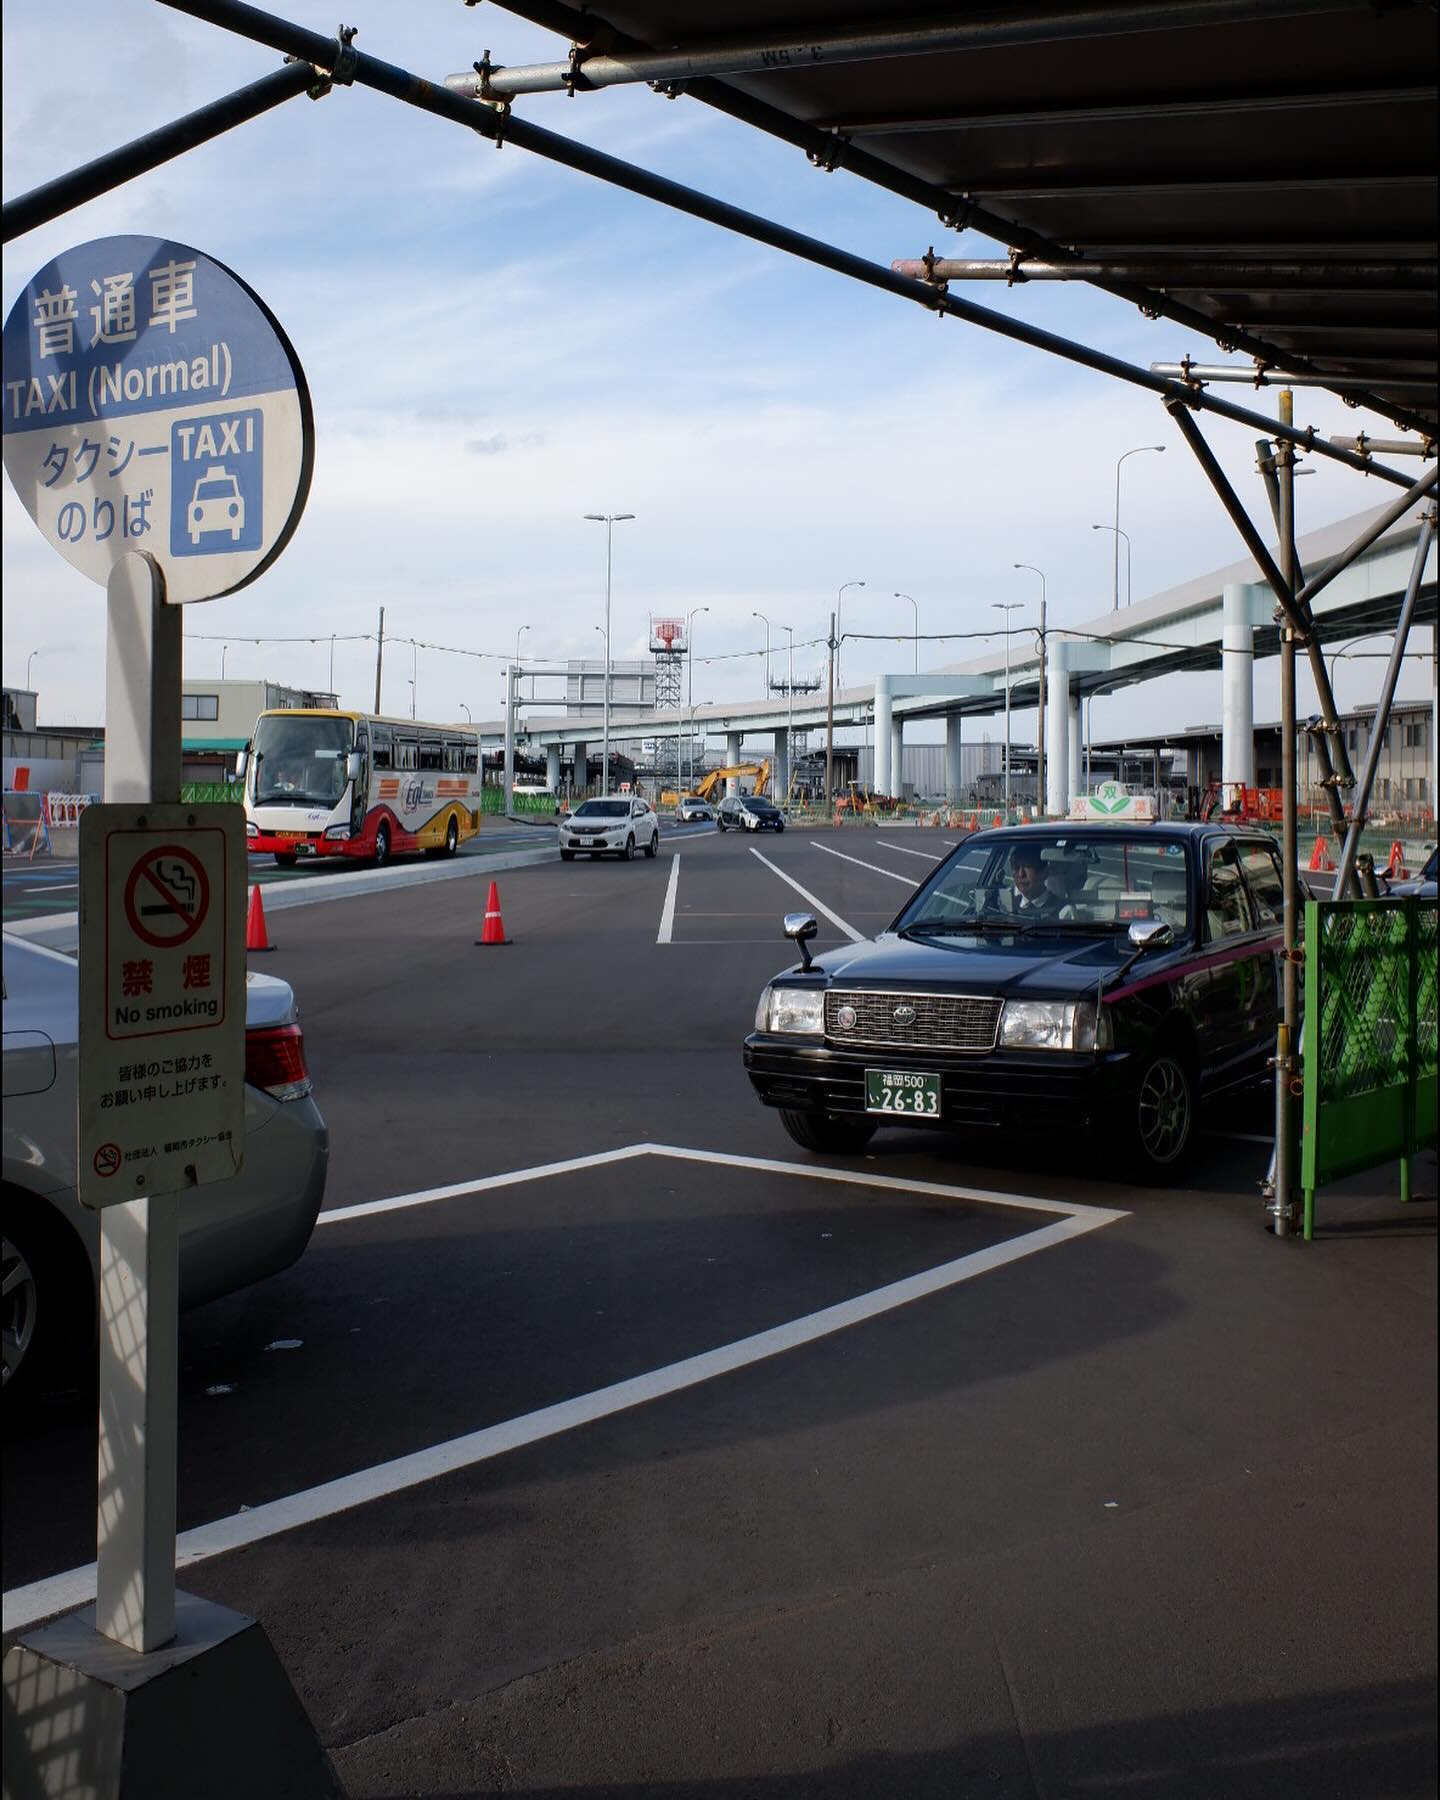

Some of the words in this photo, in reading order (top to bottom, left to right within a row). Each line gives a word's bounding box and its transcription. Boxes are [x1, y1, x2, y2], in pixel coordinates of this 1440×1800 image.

[33, 259, 199, 360] 普通車
[7, 370, 77, 419] TAXI
[88, 342, 233, 417] (Normal)
[177, 416, 254, 461] TAXI
[43, 436, 169, 488] タクシー
[57, 488, 154, 544] のりば
[122, 953, 211, 997] 禁煙
[115, 1006, 141, 1025] No
[146, 998, 218, 1021] smoking
[118, 1053, 213, 1082] 皆様のご協力を
[100, 1074, 227, 1108] お願い申し上げます。
[882, 1088, 936, 1113] 26-83
